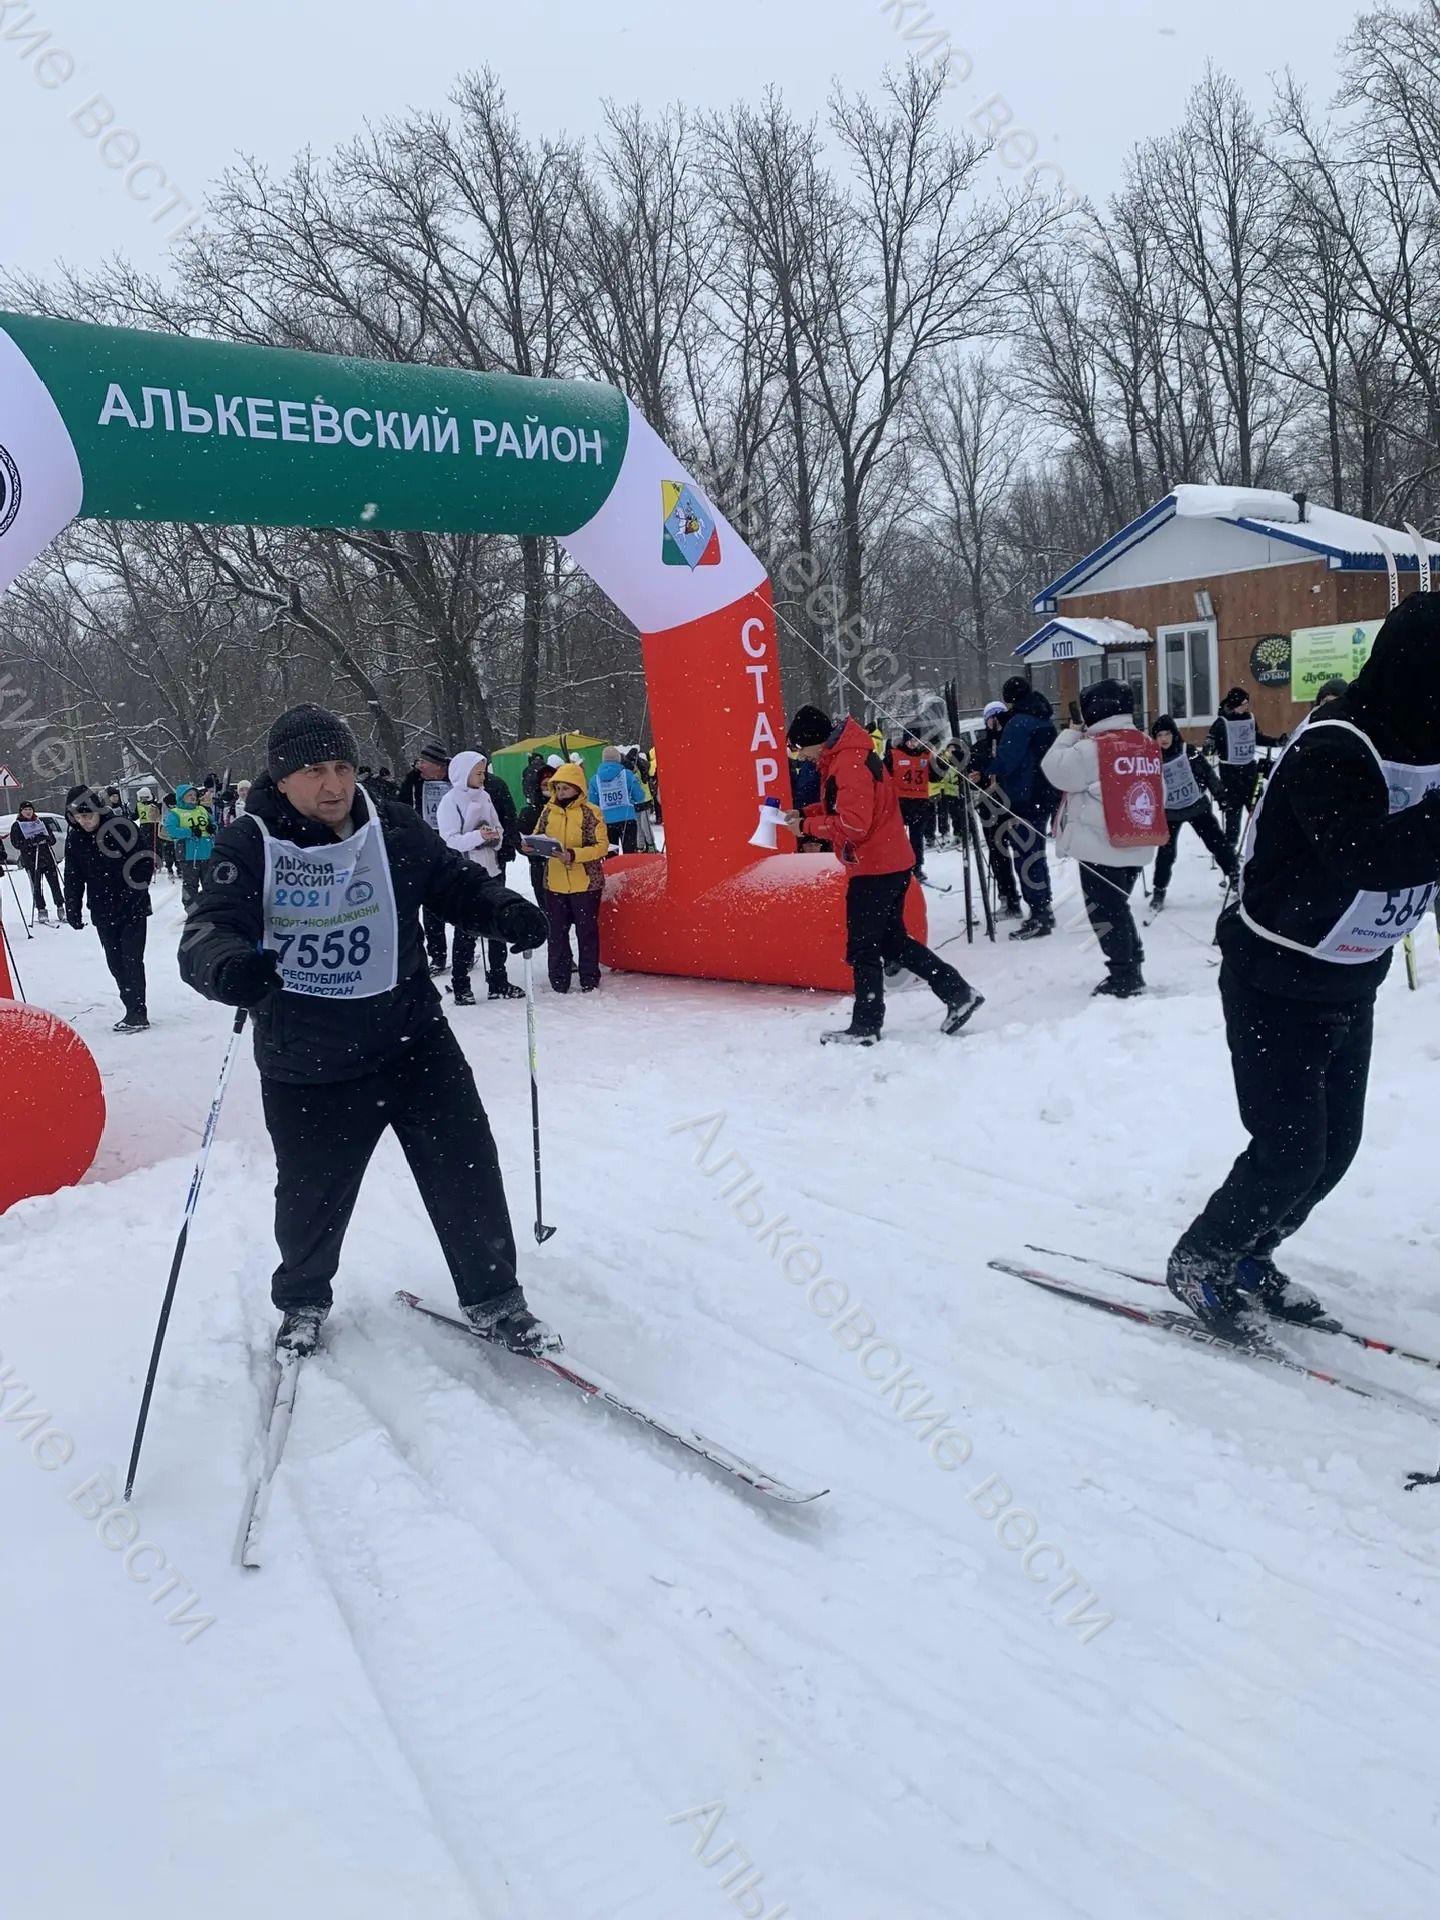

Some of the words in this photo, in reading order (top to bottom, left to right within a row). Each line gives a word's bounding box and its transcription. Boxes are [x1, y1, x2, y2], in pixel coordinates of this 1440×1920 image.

[98, 383, 460, 454] АЛЬКЕЕВСКИЙ
[474, 414, 602, 465] РАЙОН
[1052, 641, 1074, 658] КПП
[741, 617, 779, 797] СТАР
[1114, 756, 1160, 776] СУДЬЯ
[903, 769, 923, 785] 43
[603, 790, 623, 802] 7605
[1167, 782, 1193, 802] 4707
[274, 856, 334, 874] ЛЫЖНЯ
[275, 871, 335, 887] РОССИИ
[273, 889, 330, 907] 2021
[273, 925, 371, 970] 7558
[282, 968, 362, 984] РЕСПУБЛИКА
[286, 981, 354, 996] ТАТАРСТАН
